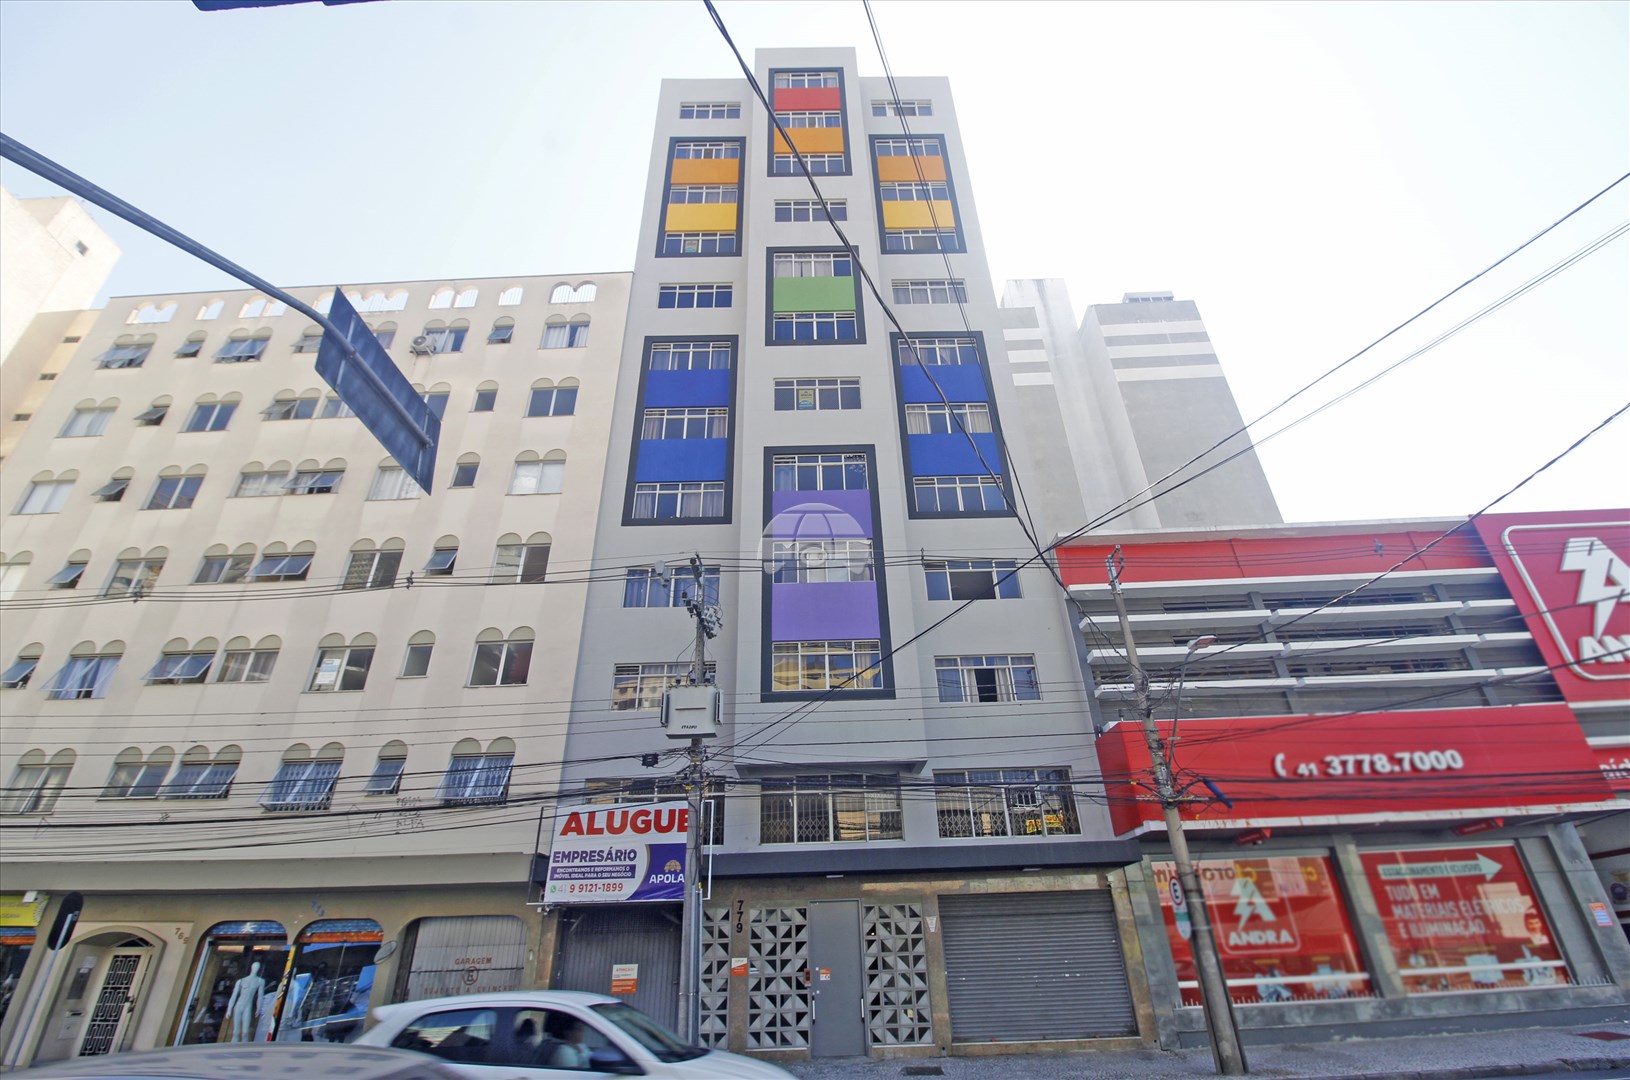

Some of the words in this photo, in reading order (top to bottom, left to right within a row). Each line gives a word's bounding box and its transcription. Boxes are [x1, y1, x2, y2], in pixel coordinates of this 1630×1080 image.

[1296, 762, 1318, 777] 41
[1323, 749, 1464, 776] 3778.7000
[552, 846, 638, 863] EMPRESÁRIO
[649, 873, 685, 884] APOLA
[569, 883, 576, 893] 9
[578, 882, 624, 893] 9121-1899
[1385, 885, 1420, 901] TUDO
[1419, 883, 1440, 899] EM
[736, 900, 744, 934] 779
[1391, 901, 1459, 919] MATERIAIS
[1229, 929, 1294, 946] ANDRA
[1397, 922, 1408, 940] E
[455, 957, 492, 965] GARAGEM
